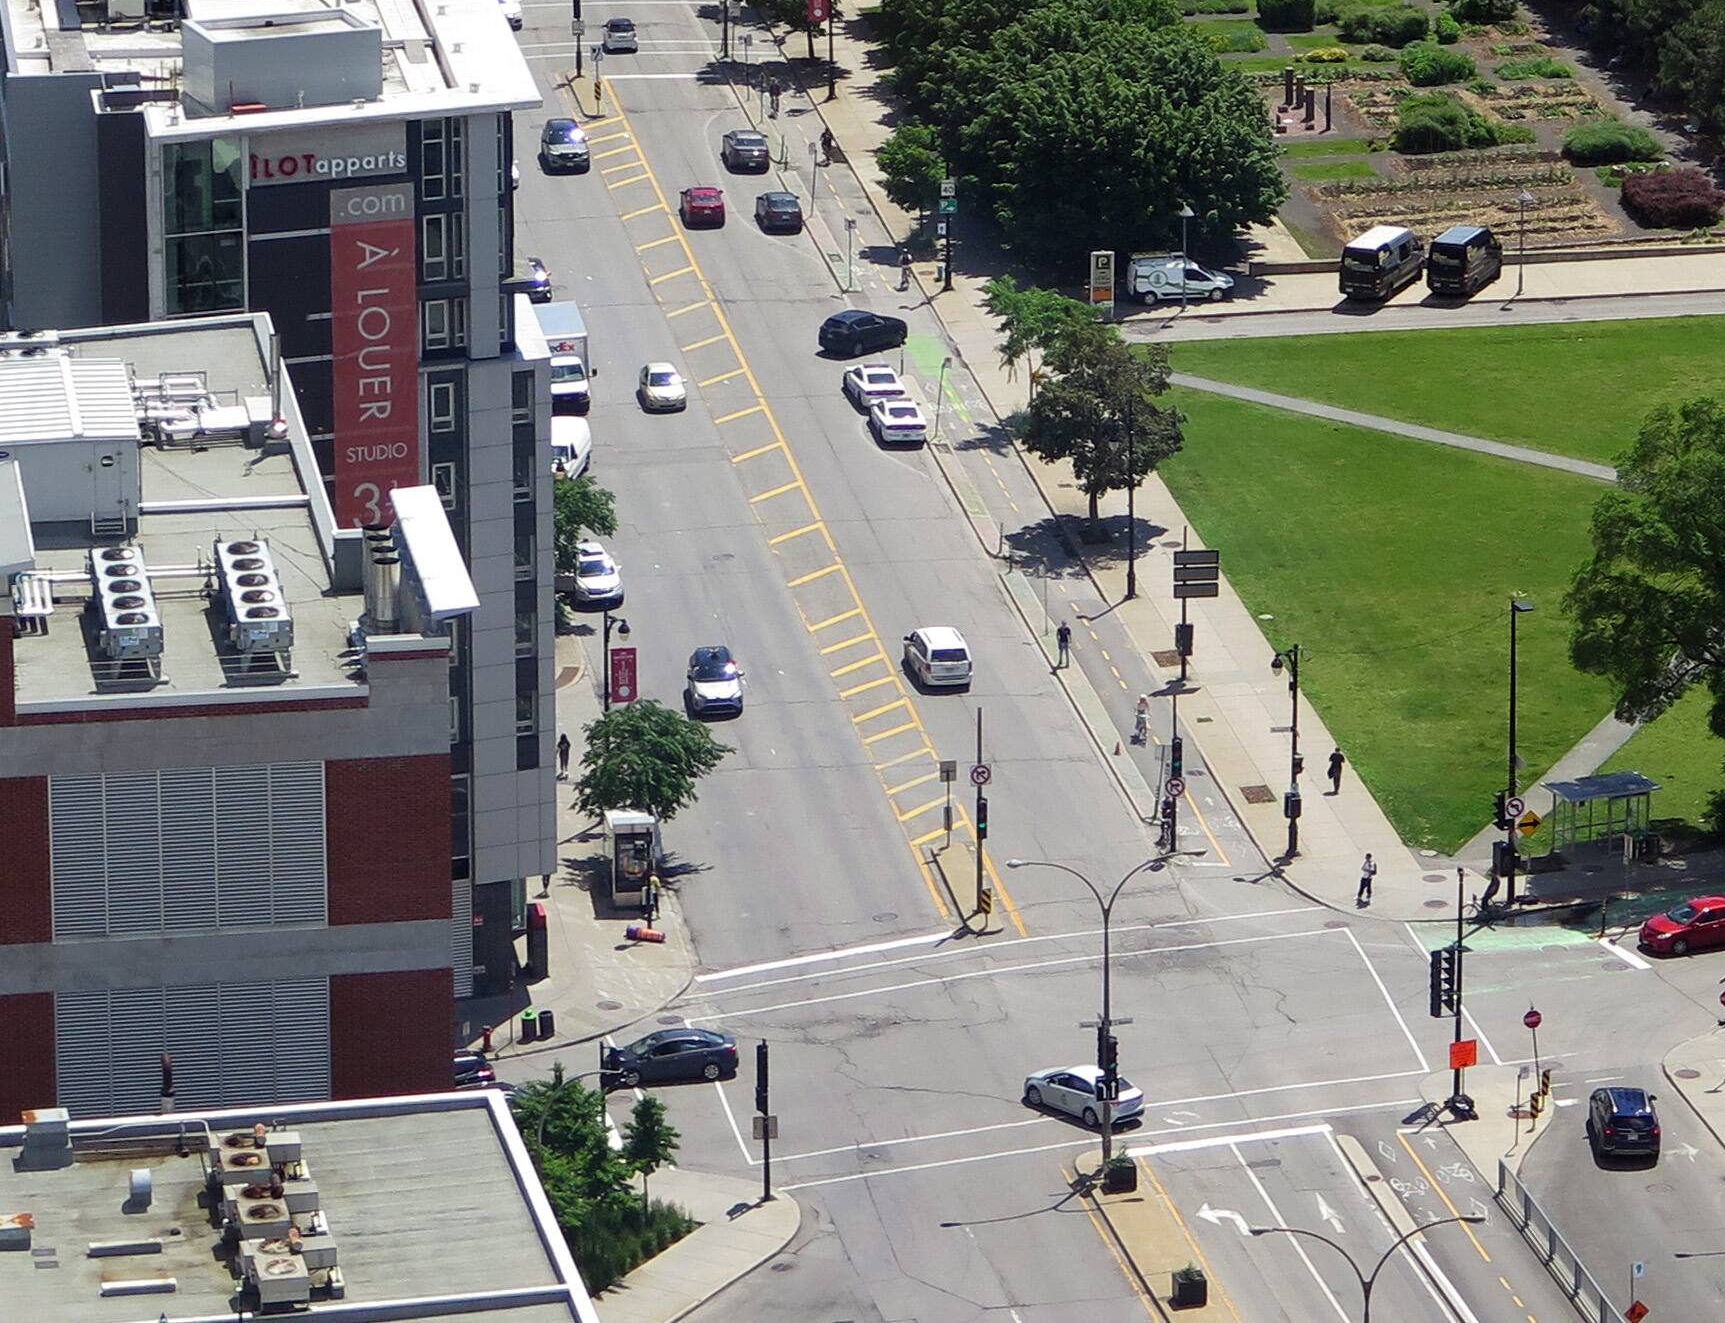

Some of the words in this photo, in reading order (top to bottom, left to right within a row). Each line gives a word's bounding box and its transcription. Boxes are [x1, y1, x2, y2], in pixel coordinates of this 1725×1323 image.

[339, 193, 405, 217] .com
[356, 240, 400, 269] À
[357, 288, 392, 422] LOUER
[346, 442, 408, 463] STUDIO
